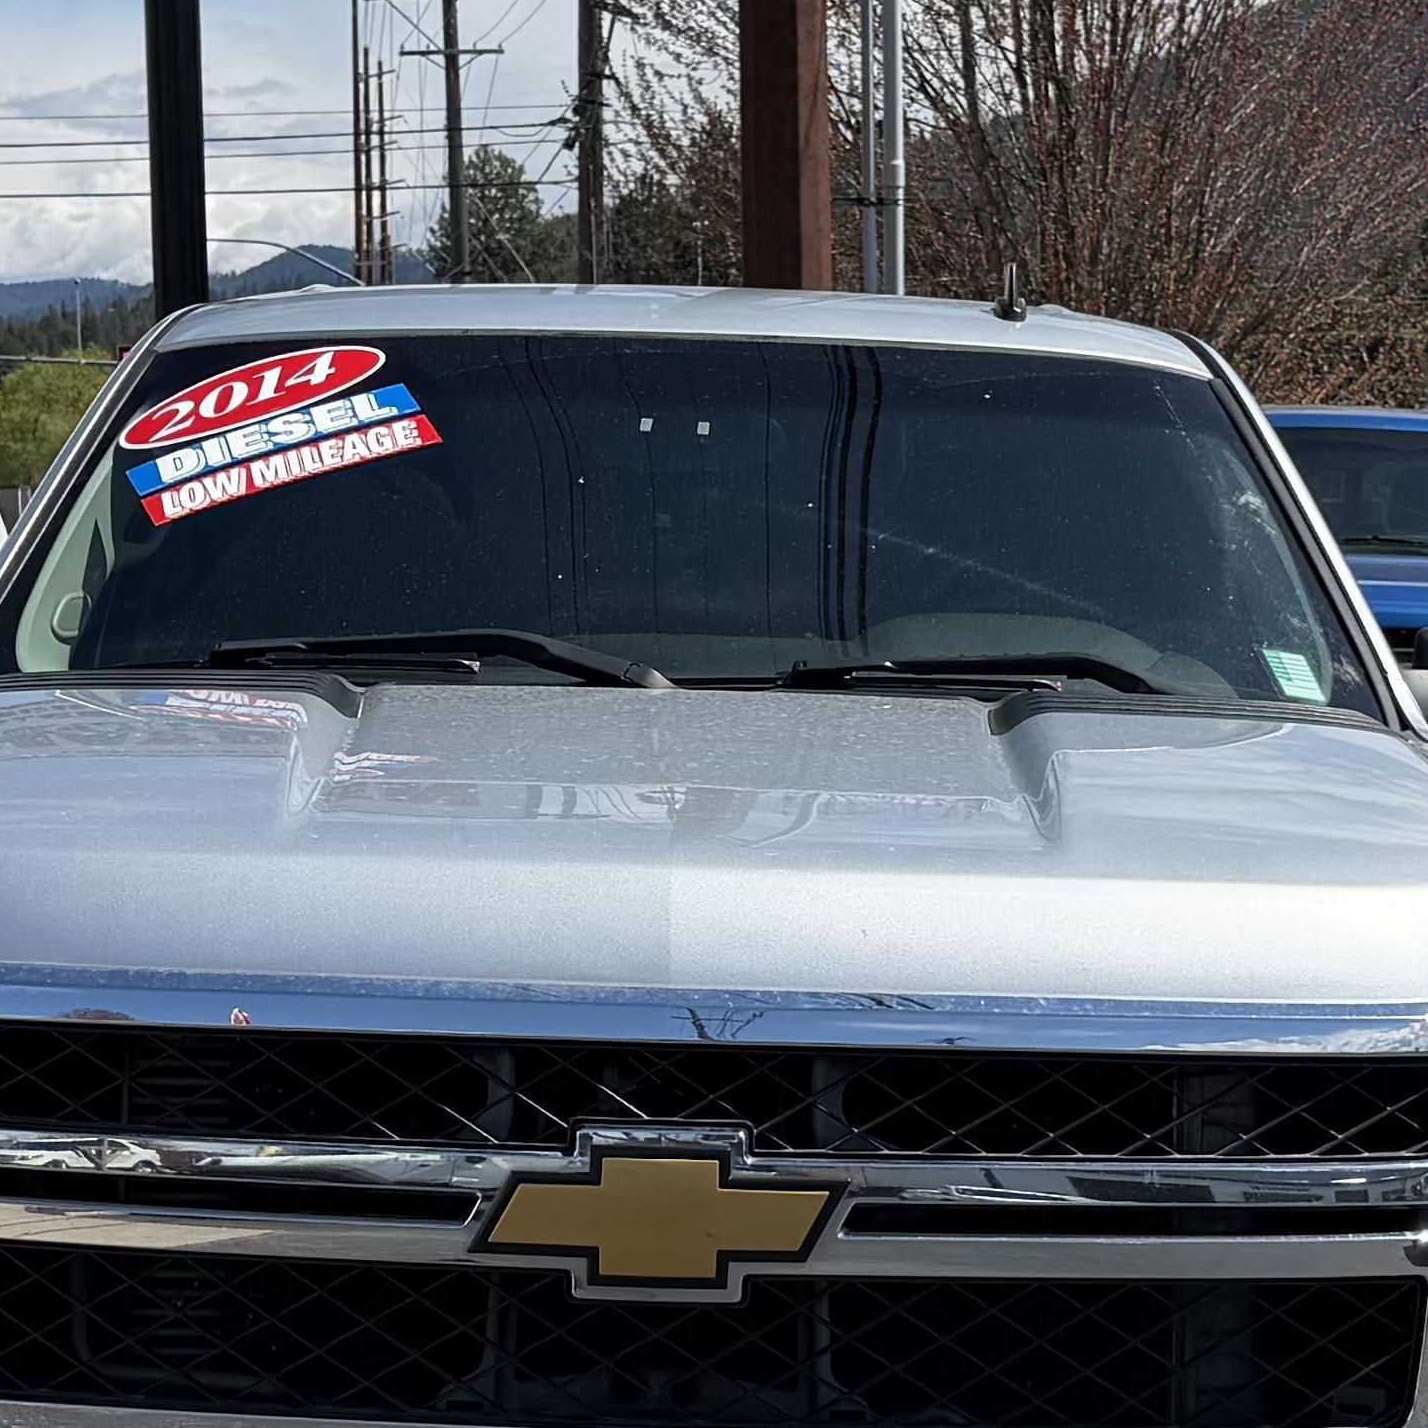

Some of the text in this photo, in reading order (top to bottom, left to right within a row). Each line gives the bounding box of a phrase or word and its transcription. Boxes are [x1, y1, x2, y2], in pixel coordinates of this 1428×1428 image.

[148, 351, 337, 443] 2014
[156, 393, 398, 484] DIESEL
[252, 420, 422, 487] MILEAGE
